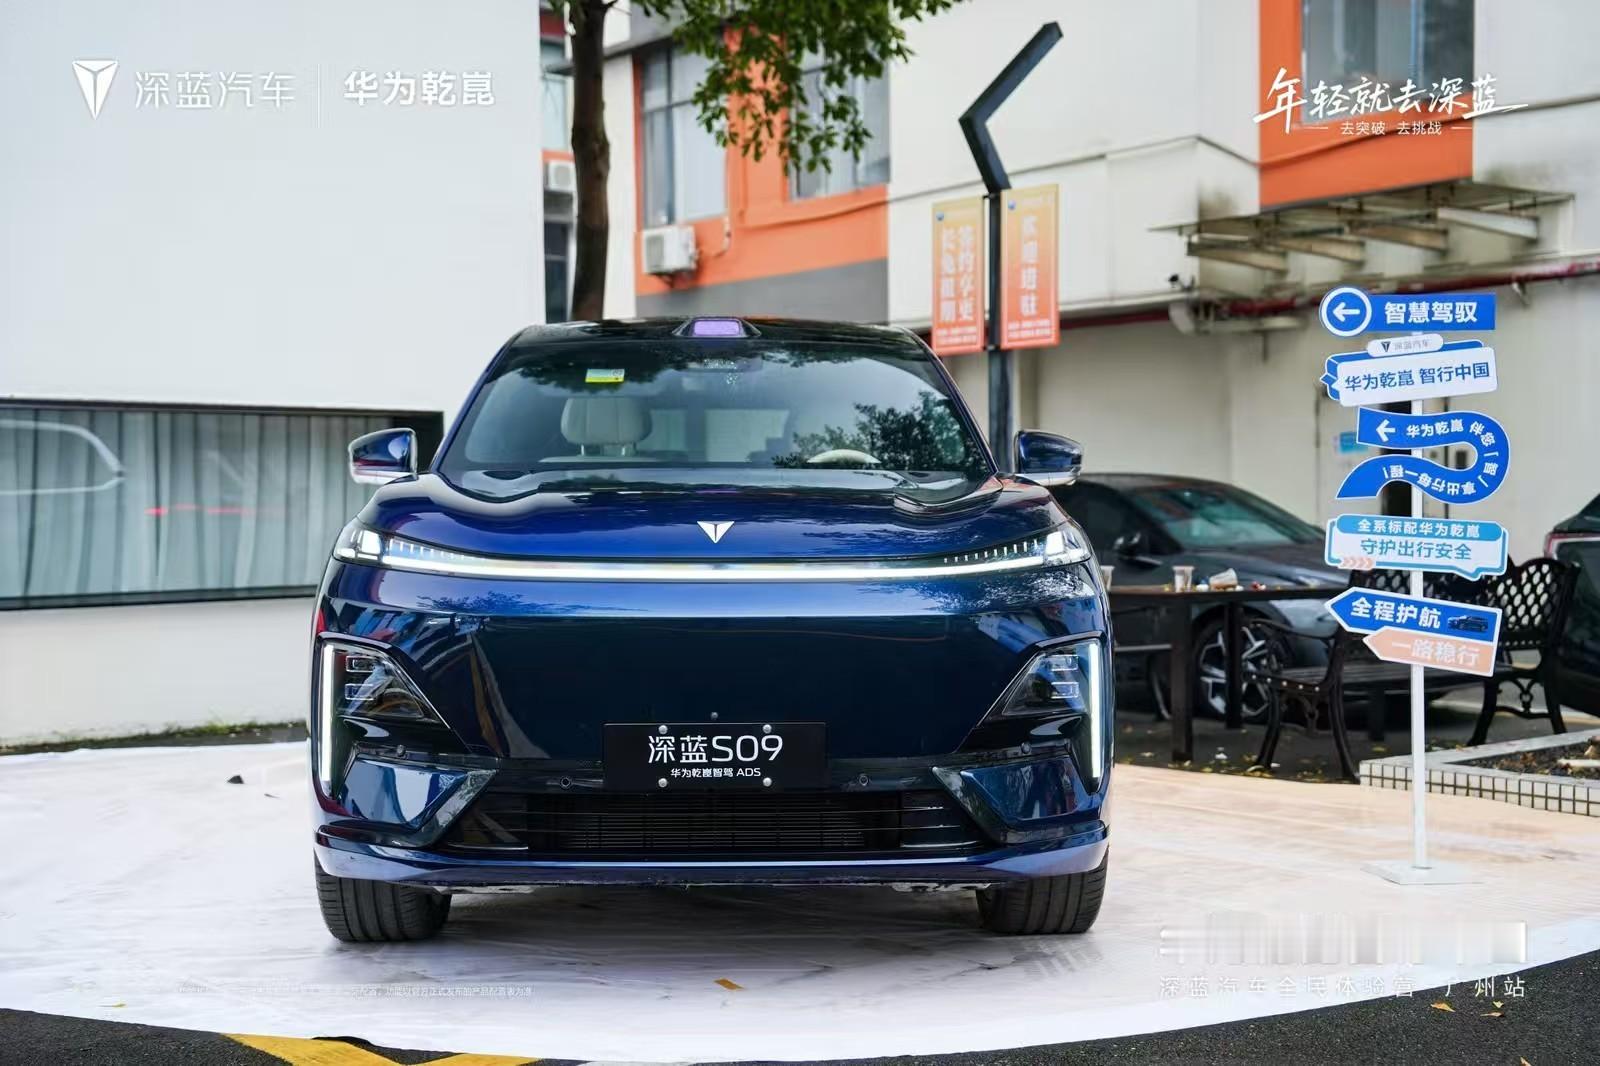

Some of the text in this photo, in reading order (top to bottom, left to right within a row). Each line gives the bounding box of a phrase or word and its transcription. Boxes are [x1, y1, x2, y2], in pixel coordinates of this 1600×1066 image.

[1384, 301, 1478, 325] 智慧驾驭
[1344, 361, 1490, 392] 华为乾崑 智行中国
[1406, 418, 1464, 439] 华为乾崑
[1357, 518, 1480, 538] 全系标配华为乾崑
[1360, 538, 1472, 561] 守护出行安全
[1350, 596, 1442, 629] 全程护航
[1391, 638, 1480, 667] 一路稳行
[648, 734, 784, 764] 深蓝S09
[670, 767, 761, 779] 华为乾崑智驾 ADS
